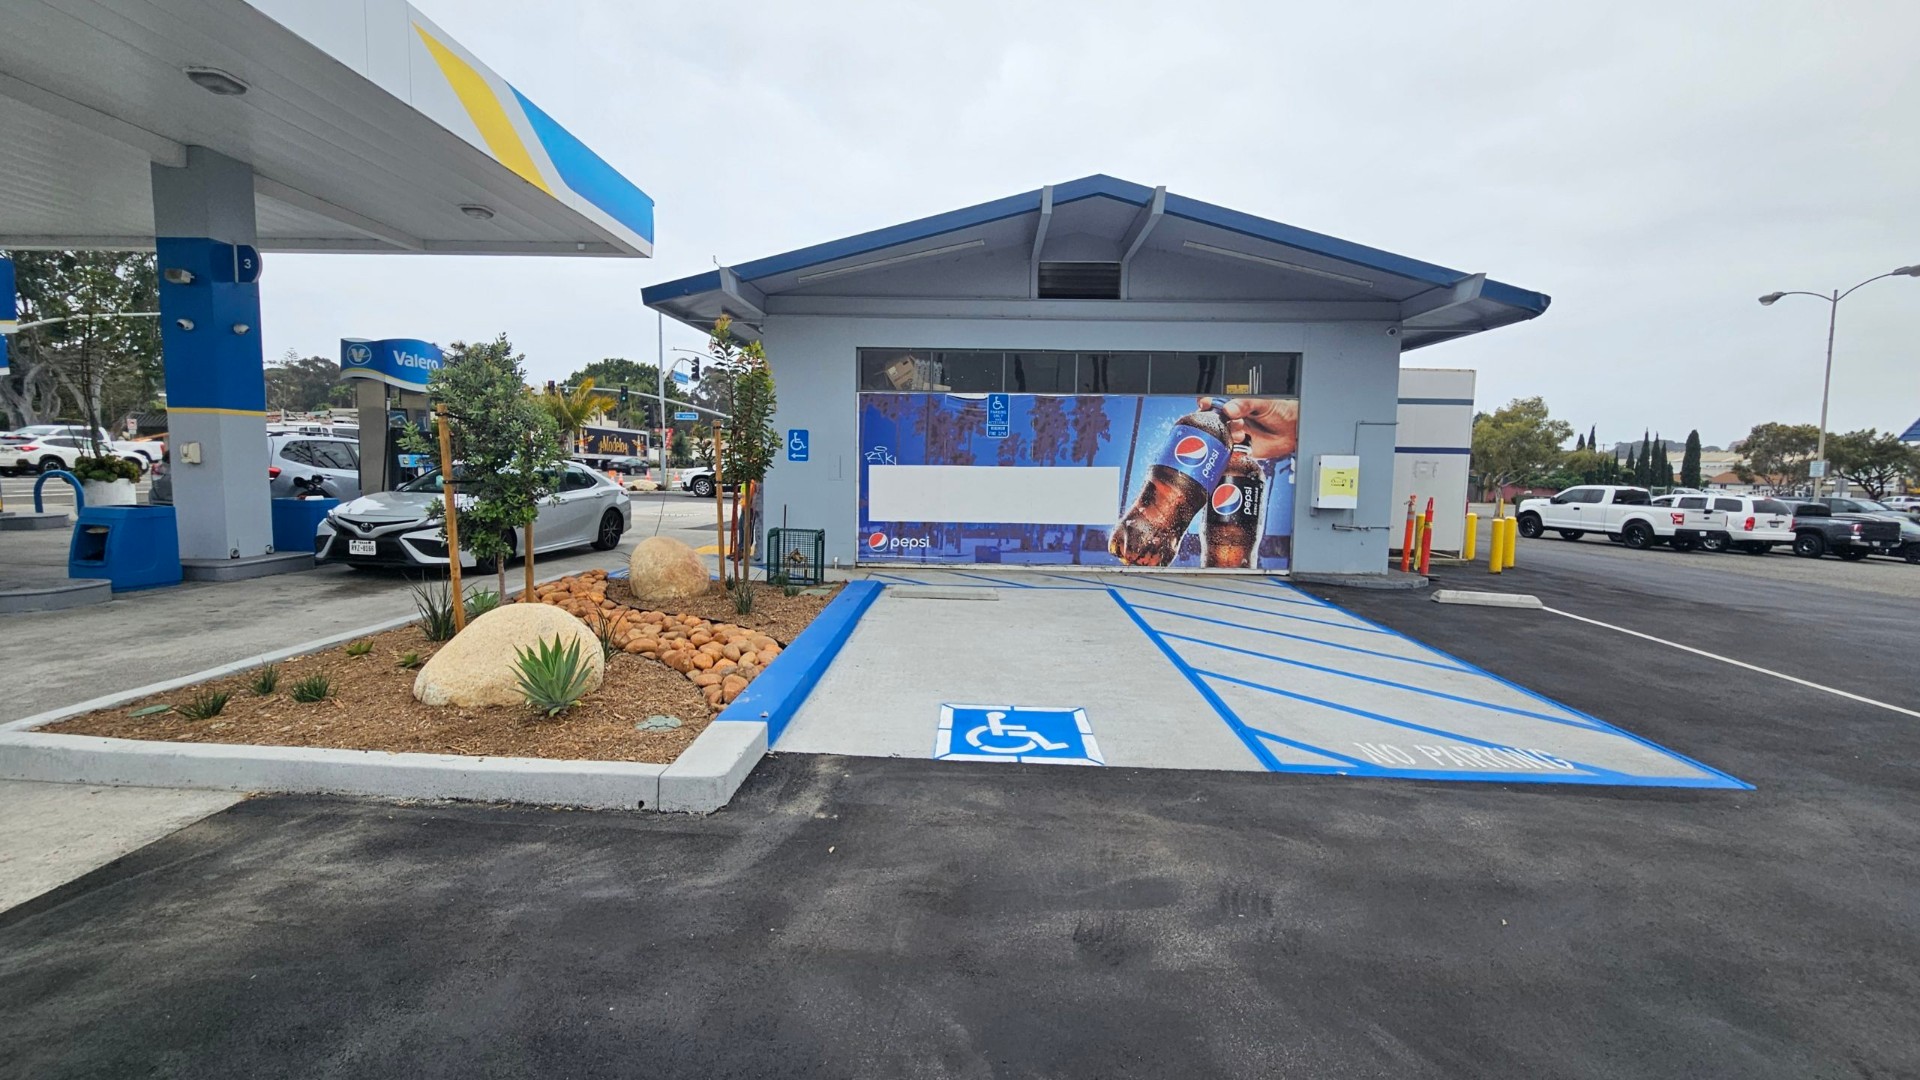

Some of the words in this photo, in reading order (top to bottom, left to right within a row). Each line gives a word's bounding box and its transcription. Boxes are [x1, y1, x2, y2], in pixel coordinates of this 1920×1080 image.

[244, 258, 252, 269] 3
[393, 350, 439, 370] Valero
[1202, 449, 1220, 478] pepsi
[1244, 486, 1252, 515] pepsi
[890, 536, 930, 550] pepsi
[1352, 742, 1416, 766] NO
[1414, 744, 1574, 770] PARKING
